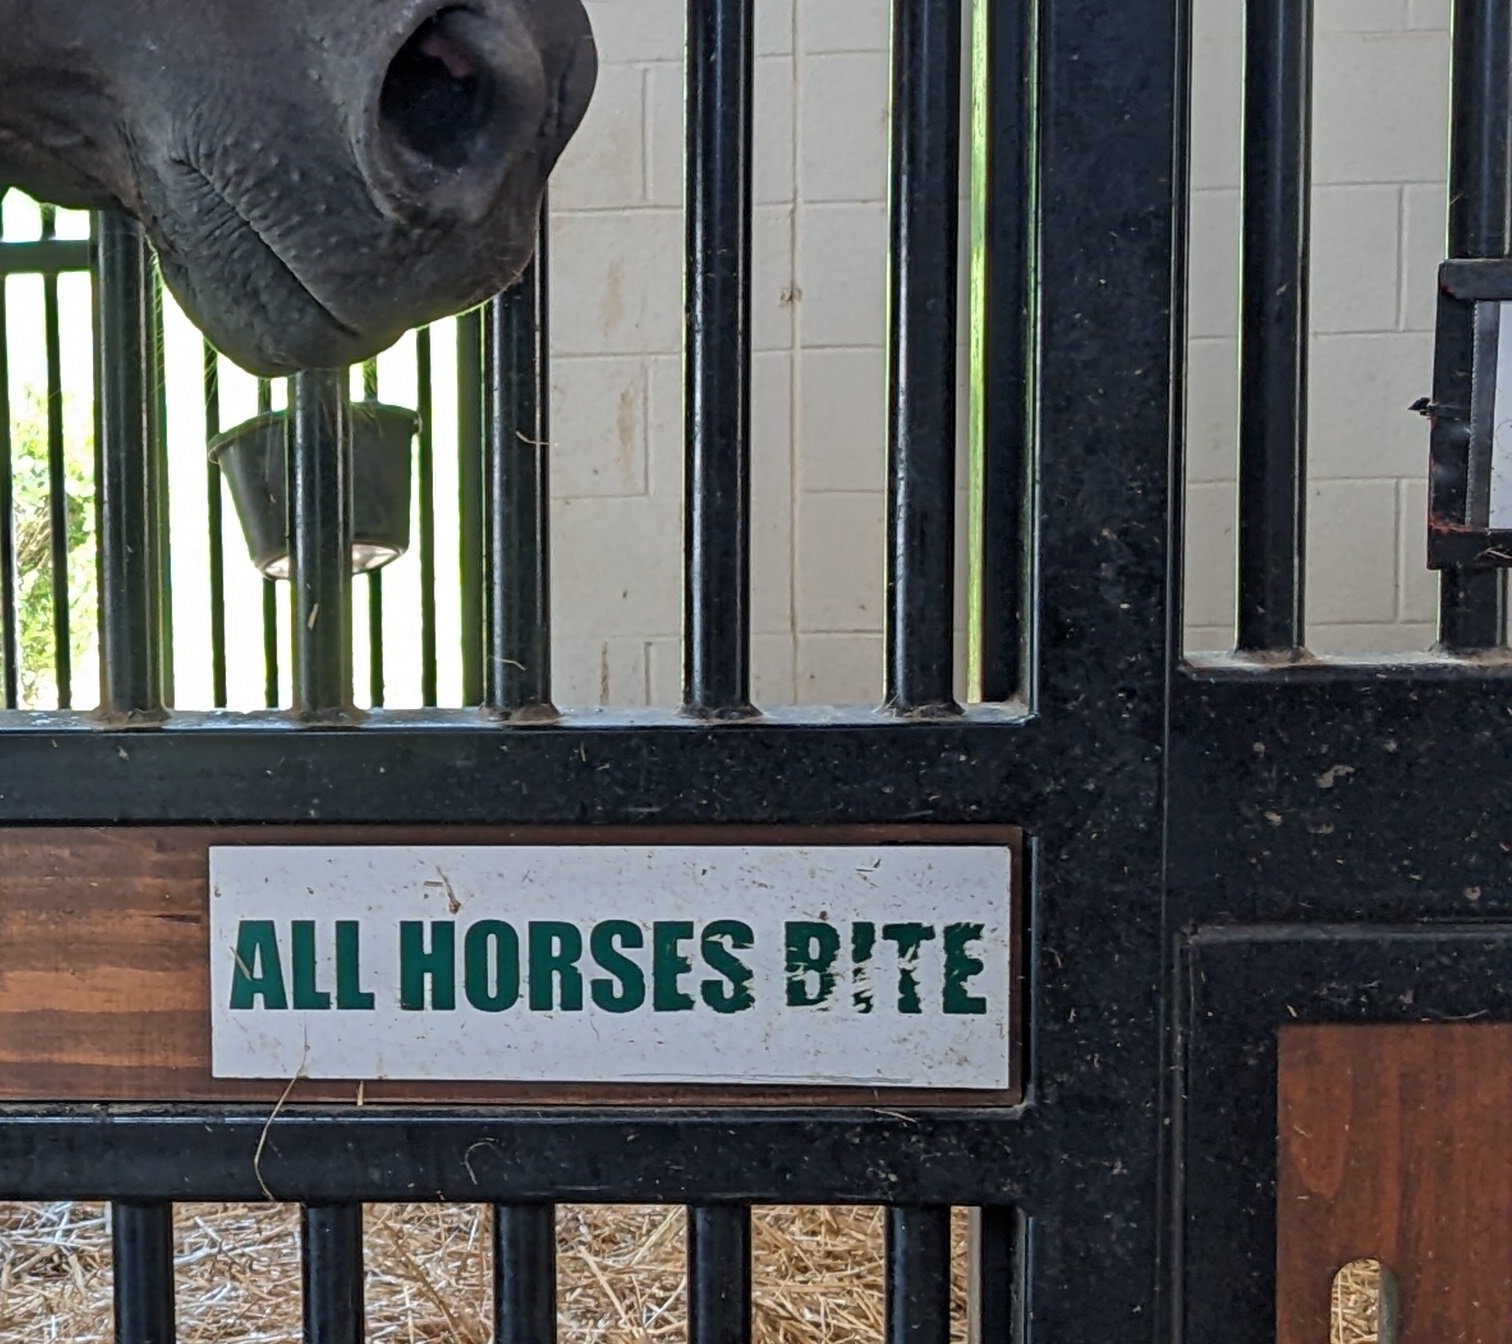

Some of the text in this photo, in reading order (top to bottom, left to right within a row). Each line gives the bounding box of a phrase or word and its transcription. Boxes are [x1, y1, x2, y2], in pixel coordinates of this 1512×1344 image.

[229, 919, 988, 1015] ALL HORSES BITE
